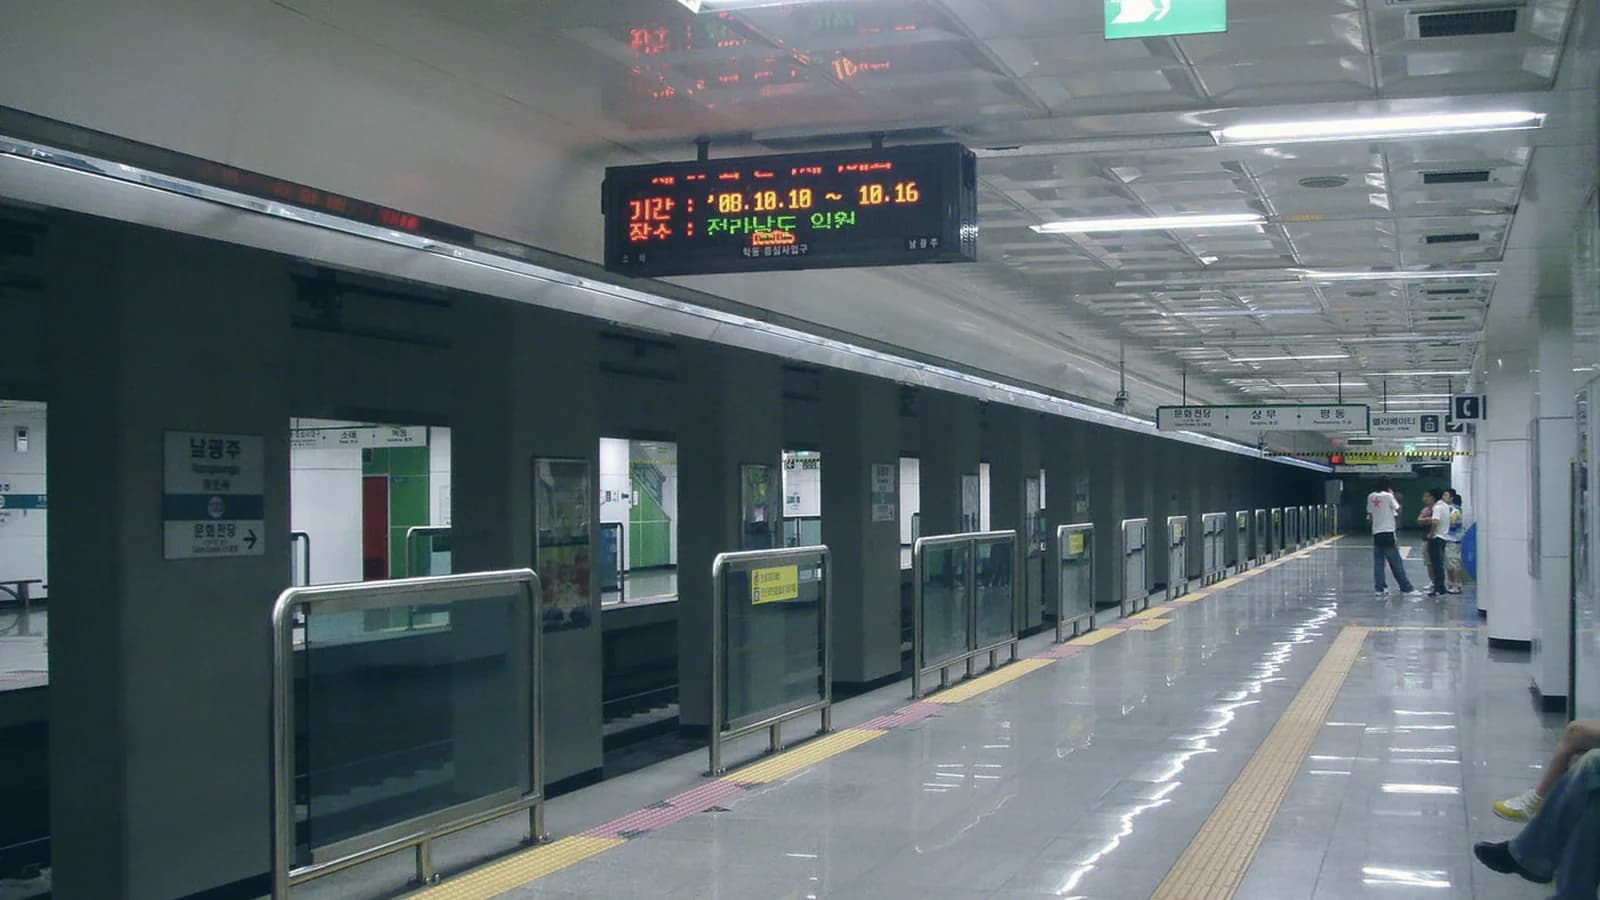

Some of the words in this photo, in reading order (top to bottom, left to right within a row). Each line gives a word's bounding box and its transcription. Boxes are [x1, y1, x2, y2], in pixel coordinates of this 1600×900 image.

[629, 197, 676, 220] 기간
[859, 181, 919, 205] 10.16
[189, 437, 241, 460] 남광주
[193, 522, 237, 538] 문화전당
